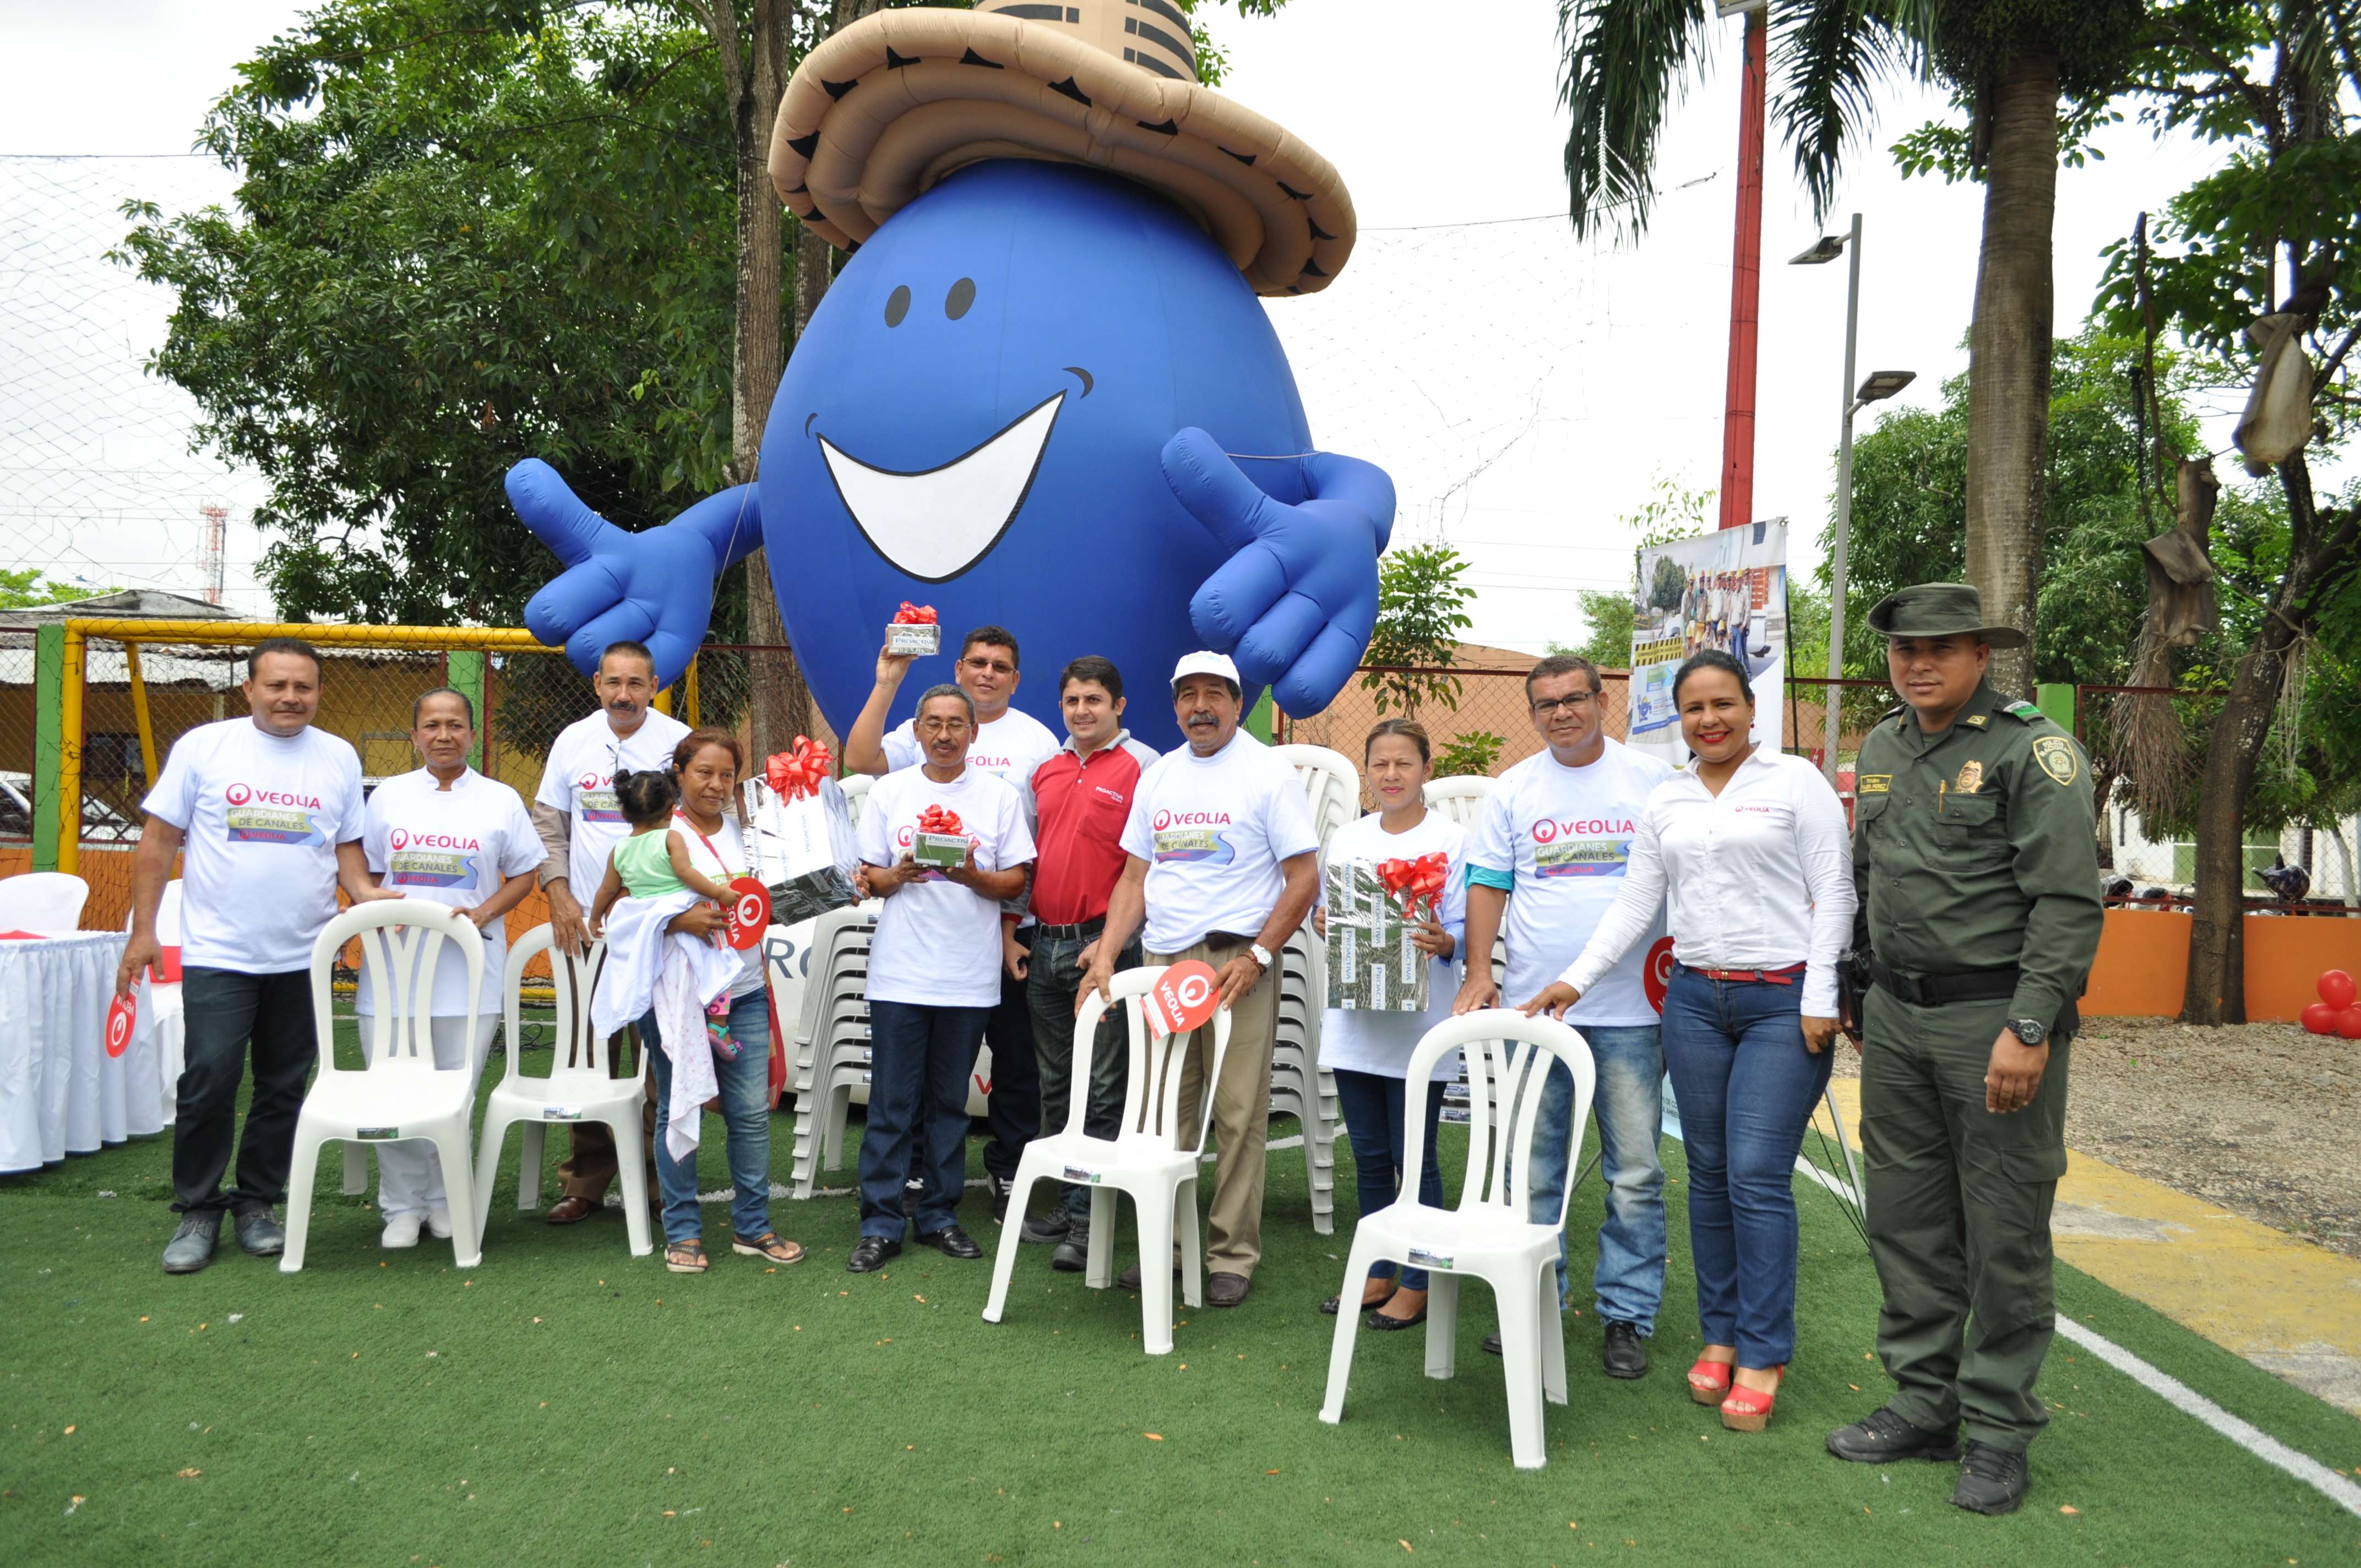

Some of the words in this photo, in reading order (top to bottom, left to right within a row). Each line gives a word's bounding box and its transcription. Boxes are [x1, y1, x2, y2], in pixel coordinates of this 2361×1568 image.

[966, 756, 1011, 766] EOLIA
[255, 790, 321, 810] VEOLIA
[231, 809, 298, 821] GUARDIANES
[1174, 812, 1231, 825] VEOLIA
[255, 819, 304, 830] CANALES
[1561, 819, 1635, 835] VEOLIA
[252, 831, 285, 841] VEOLIA
[929, 835, 969, 843] PROACTIV
[413, 834, 480, 851] VEOLIA
[1538, 842, 1608, 857] GUARDIANES
[392, 853, 453, 864] GUARDIANES
[1548, 856, 1561, 864] DE
[1563, 852, 1615, 862] CANALES
[412, 863, 458, 873] CANALES
[409, 874, 438, 883] VEOLIA
[727, 906, 740, 944] OLIA
[1160, 981, 1185, 1028] VEOLIA
